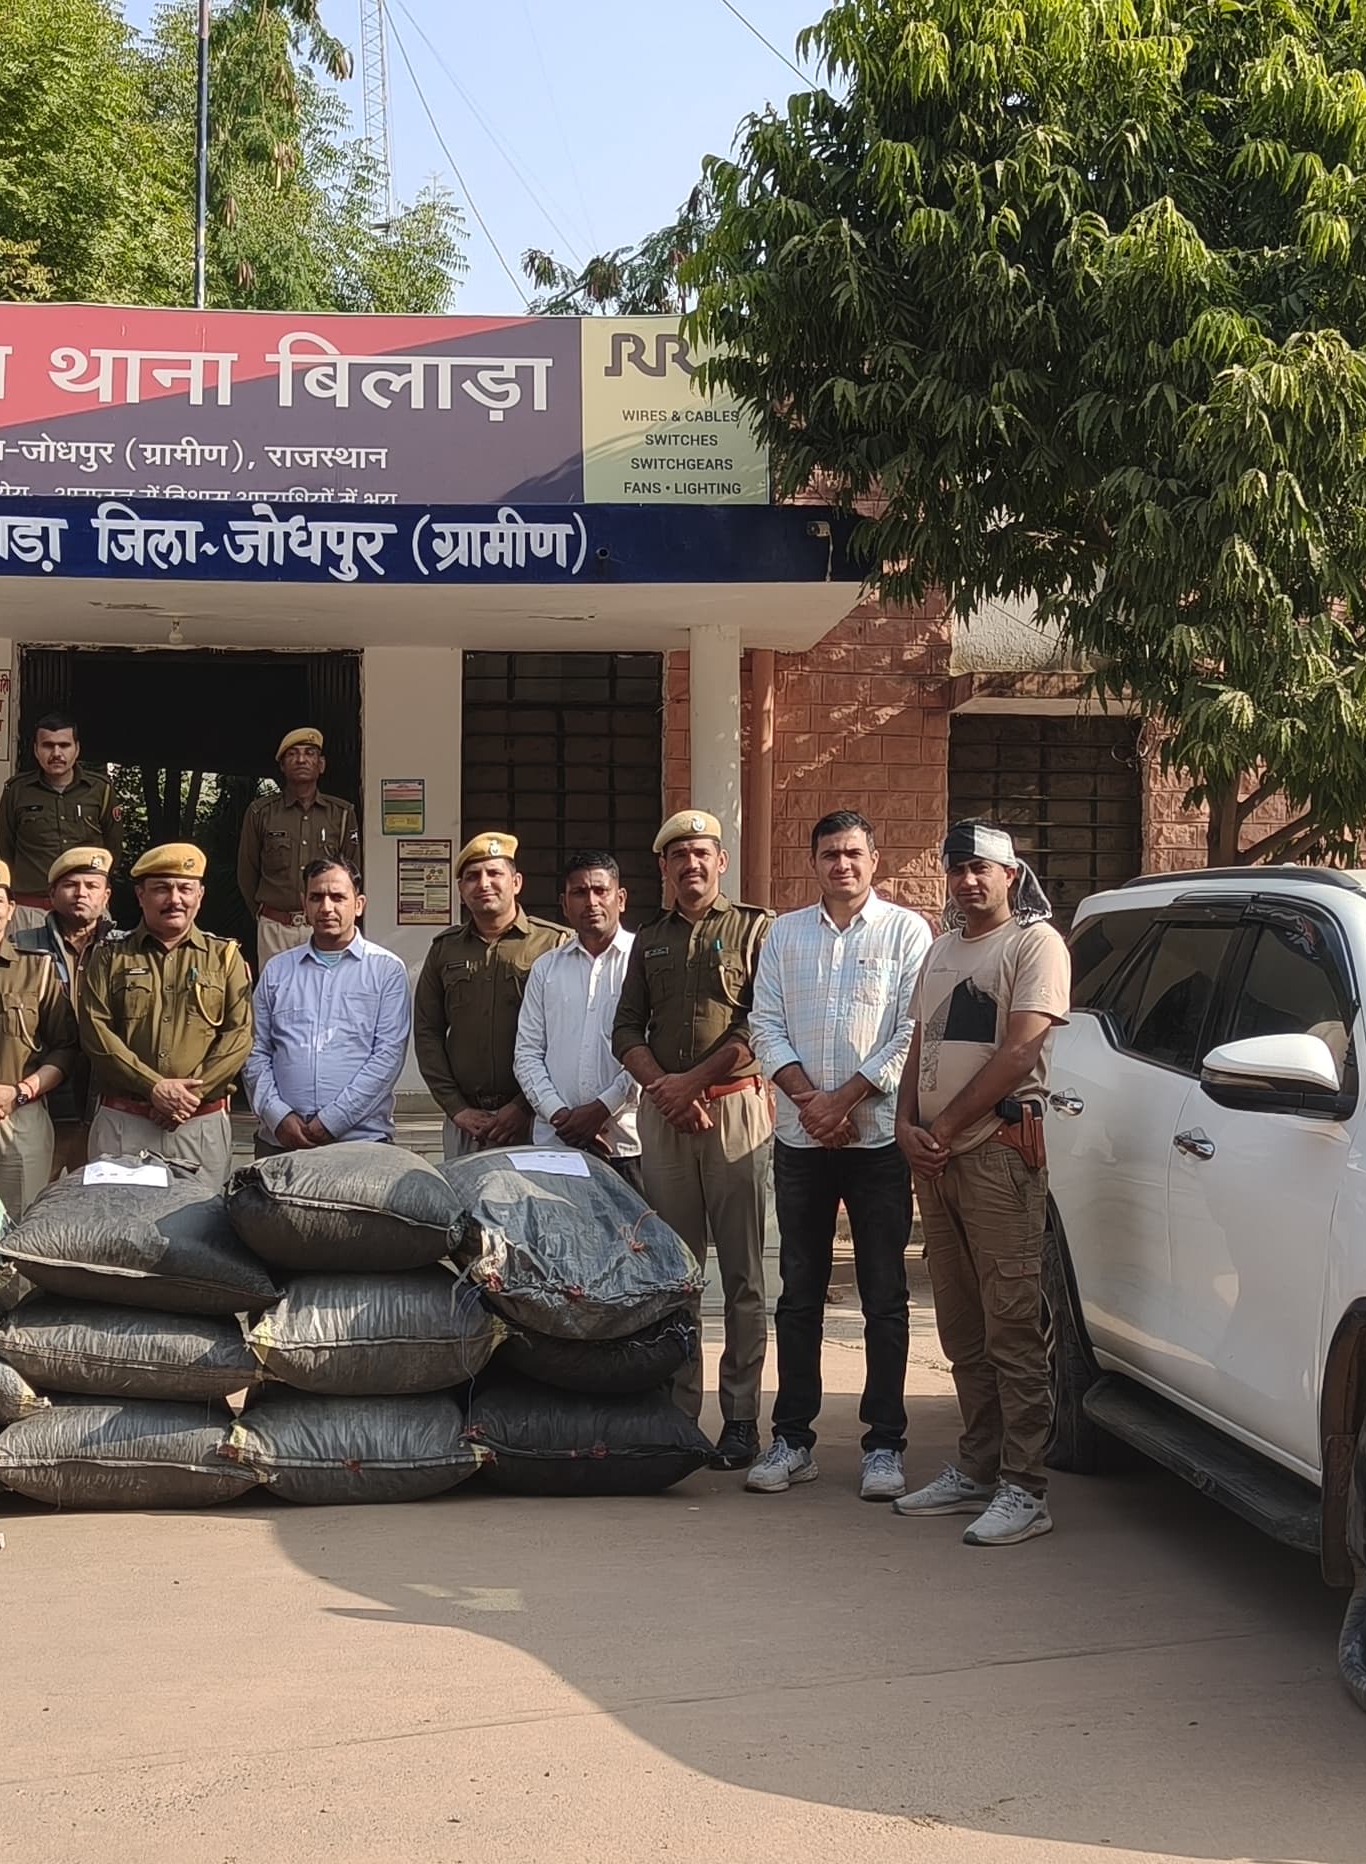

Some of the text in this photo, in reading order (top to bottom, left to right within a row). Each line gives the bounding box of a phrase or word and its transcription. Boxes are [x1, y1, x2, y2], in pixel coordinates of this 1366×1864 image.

[48, 345, 239, 404] थाना
[264, 331, 554, 422] बिलाड़ा
[622, 409, 740, 423] WIRES & CABLES
[644, 434, 718, 446] SWITCHES
[125, 436, 255, 473] (ग्रामीण),
[264, 446, 388, 469] राजस्थान
[630, 457, 733, 470] SWITCHGEARS
[623, 481, 741, 494] FANS LIGHTING
[411, 505, 588, 576] (ग्रामीण)
